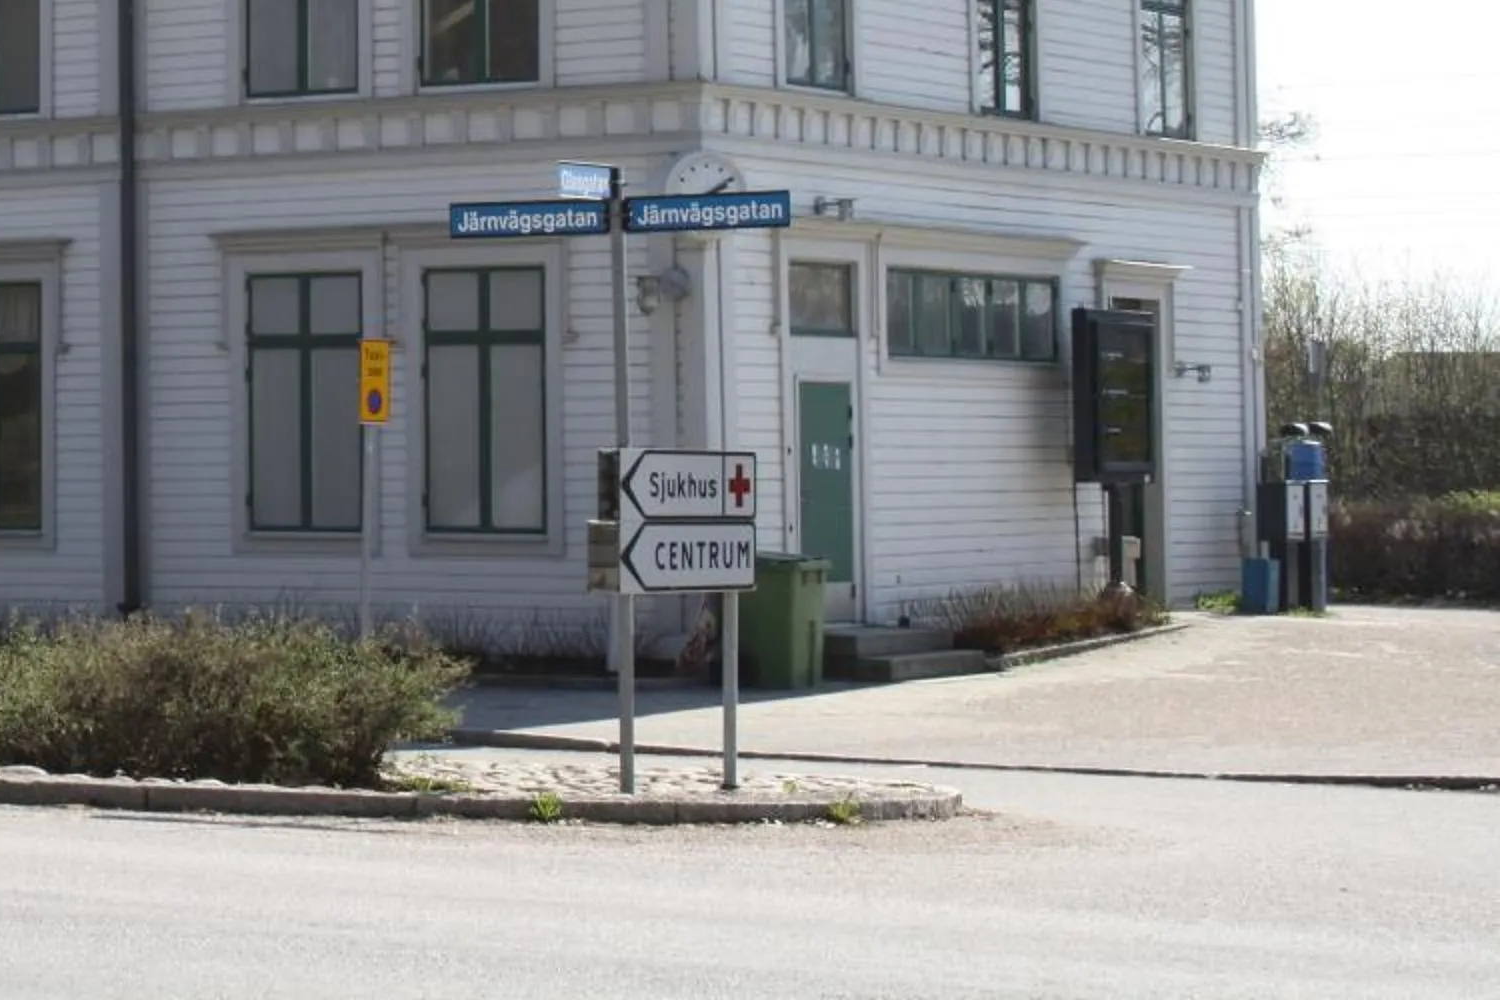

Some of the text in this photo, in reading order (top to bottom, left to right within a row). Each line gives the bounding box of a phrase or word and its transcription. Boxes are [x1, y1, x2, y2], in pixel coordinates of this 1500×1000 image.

[457, 208, 598, 234] Järnvägsgatan
[638, 196, 783, 226] Järnvägsgatan
[649, 471, 718, 504] Sjukhus
[655, 540, 751, 571] CENTRUM
